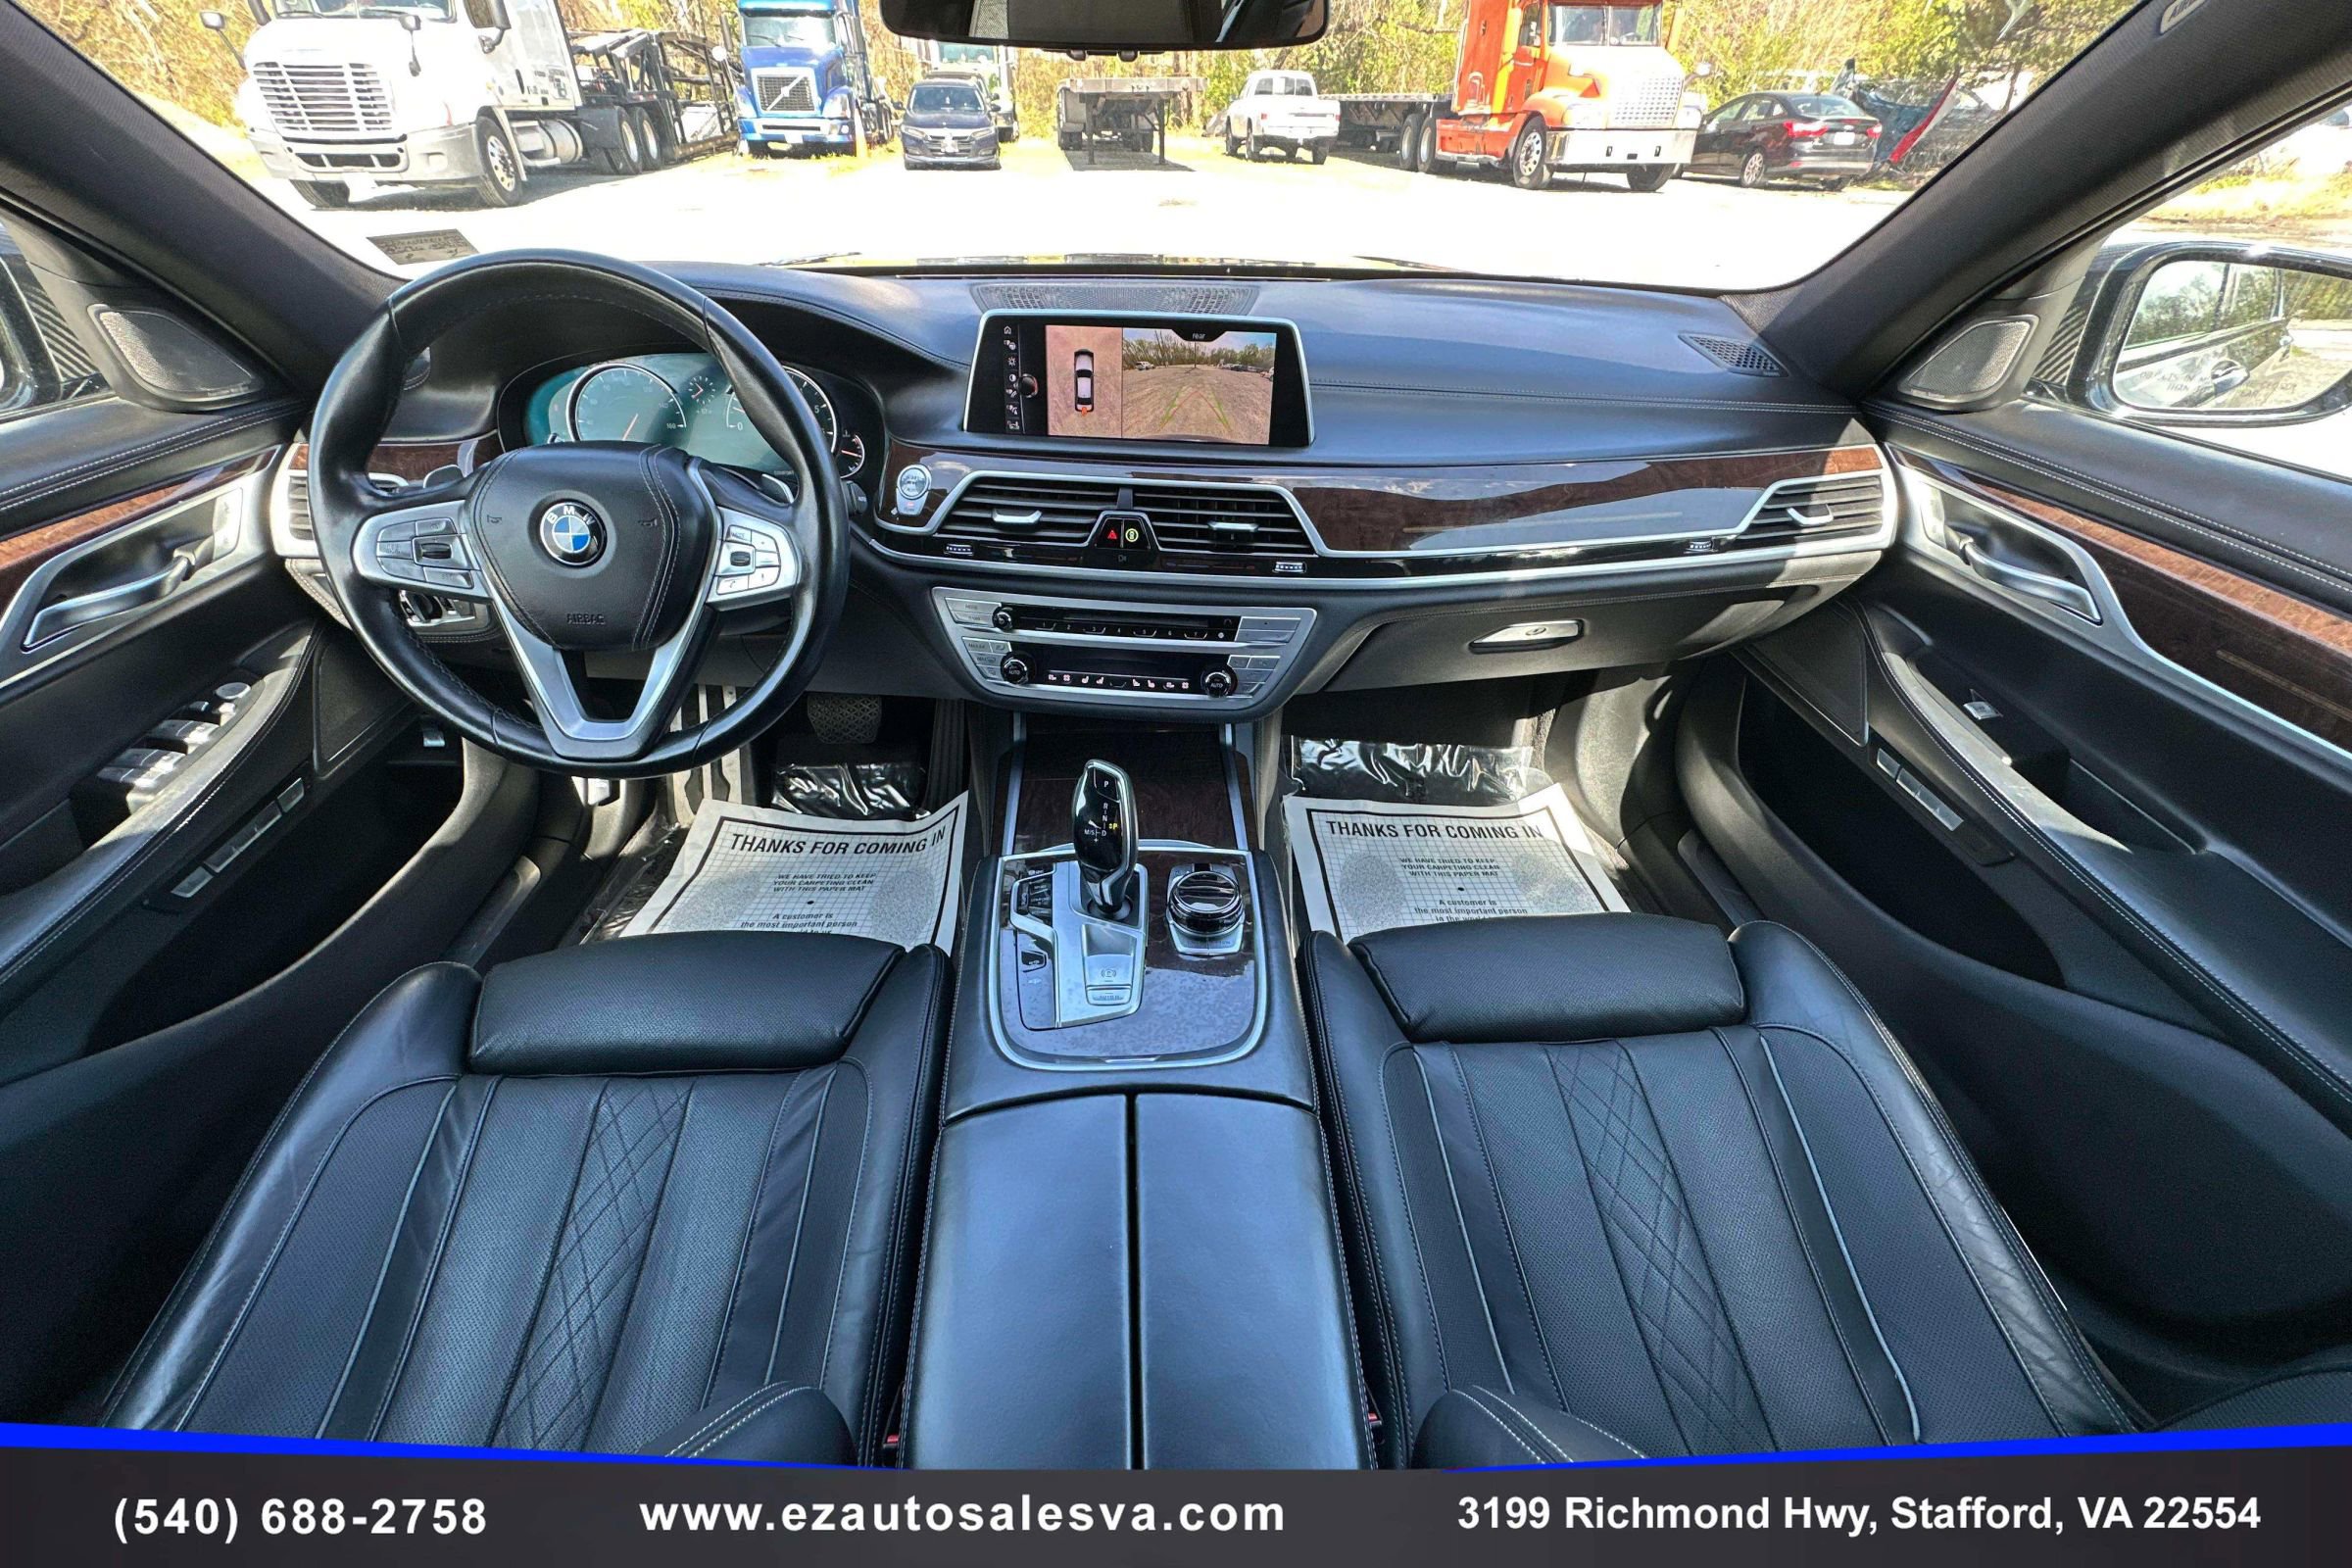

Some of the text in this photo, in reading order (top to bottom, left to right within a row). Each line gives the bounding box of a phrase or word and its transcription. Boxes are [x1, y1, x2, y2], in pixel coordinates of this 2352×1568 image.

[546, 505, 596, 525] BMW
[1326, 820, 1544, 840] THANKS FOR COMING IN
[730, 826, 946, 855] THANKS FOR COMING IN
[782, 920, 825, 929] important
